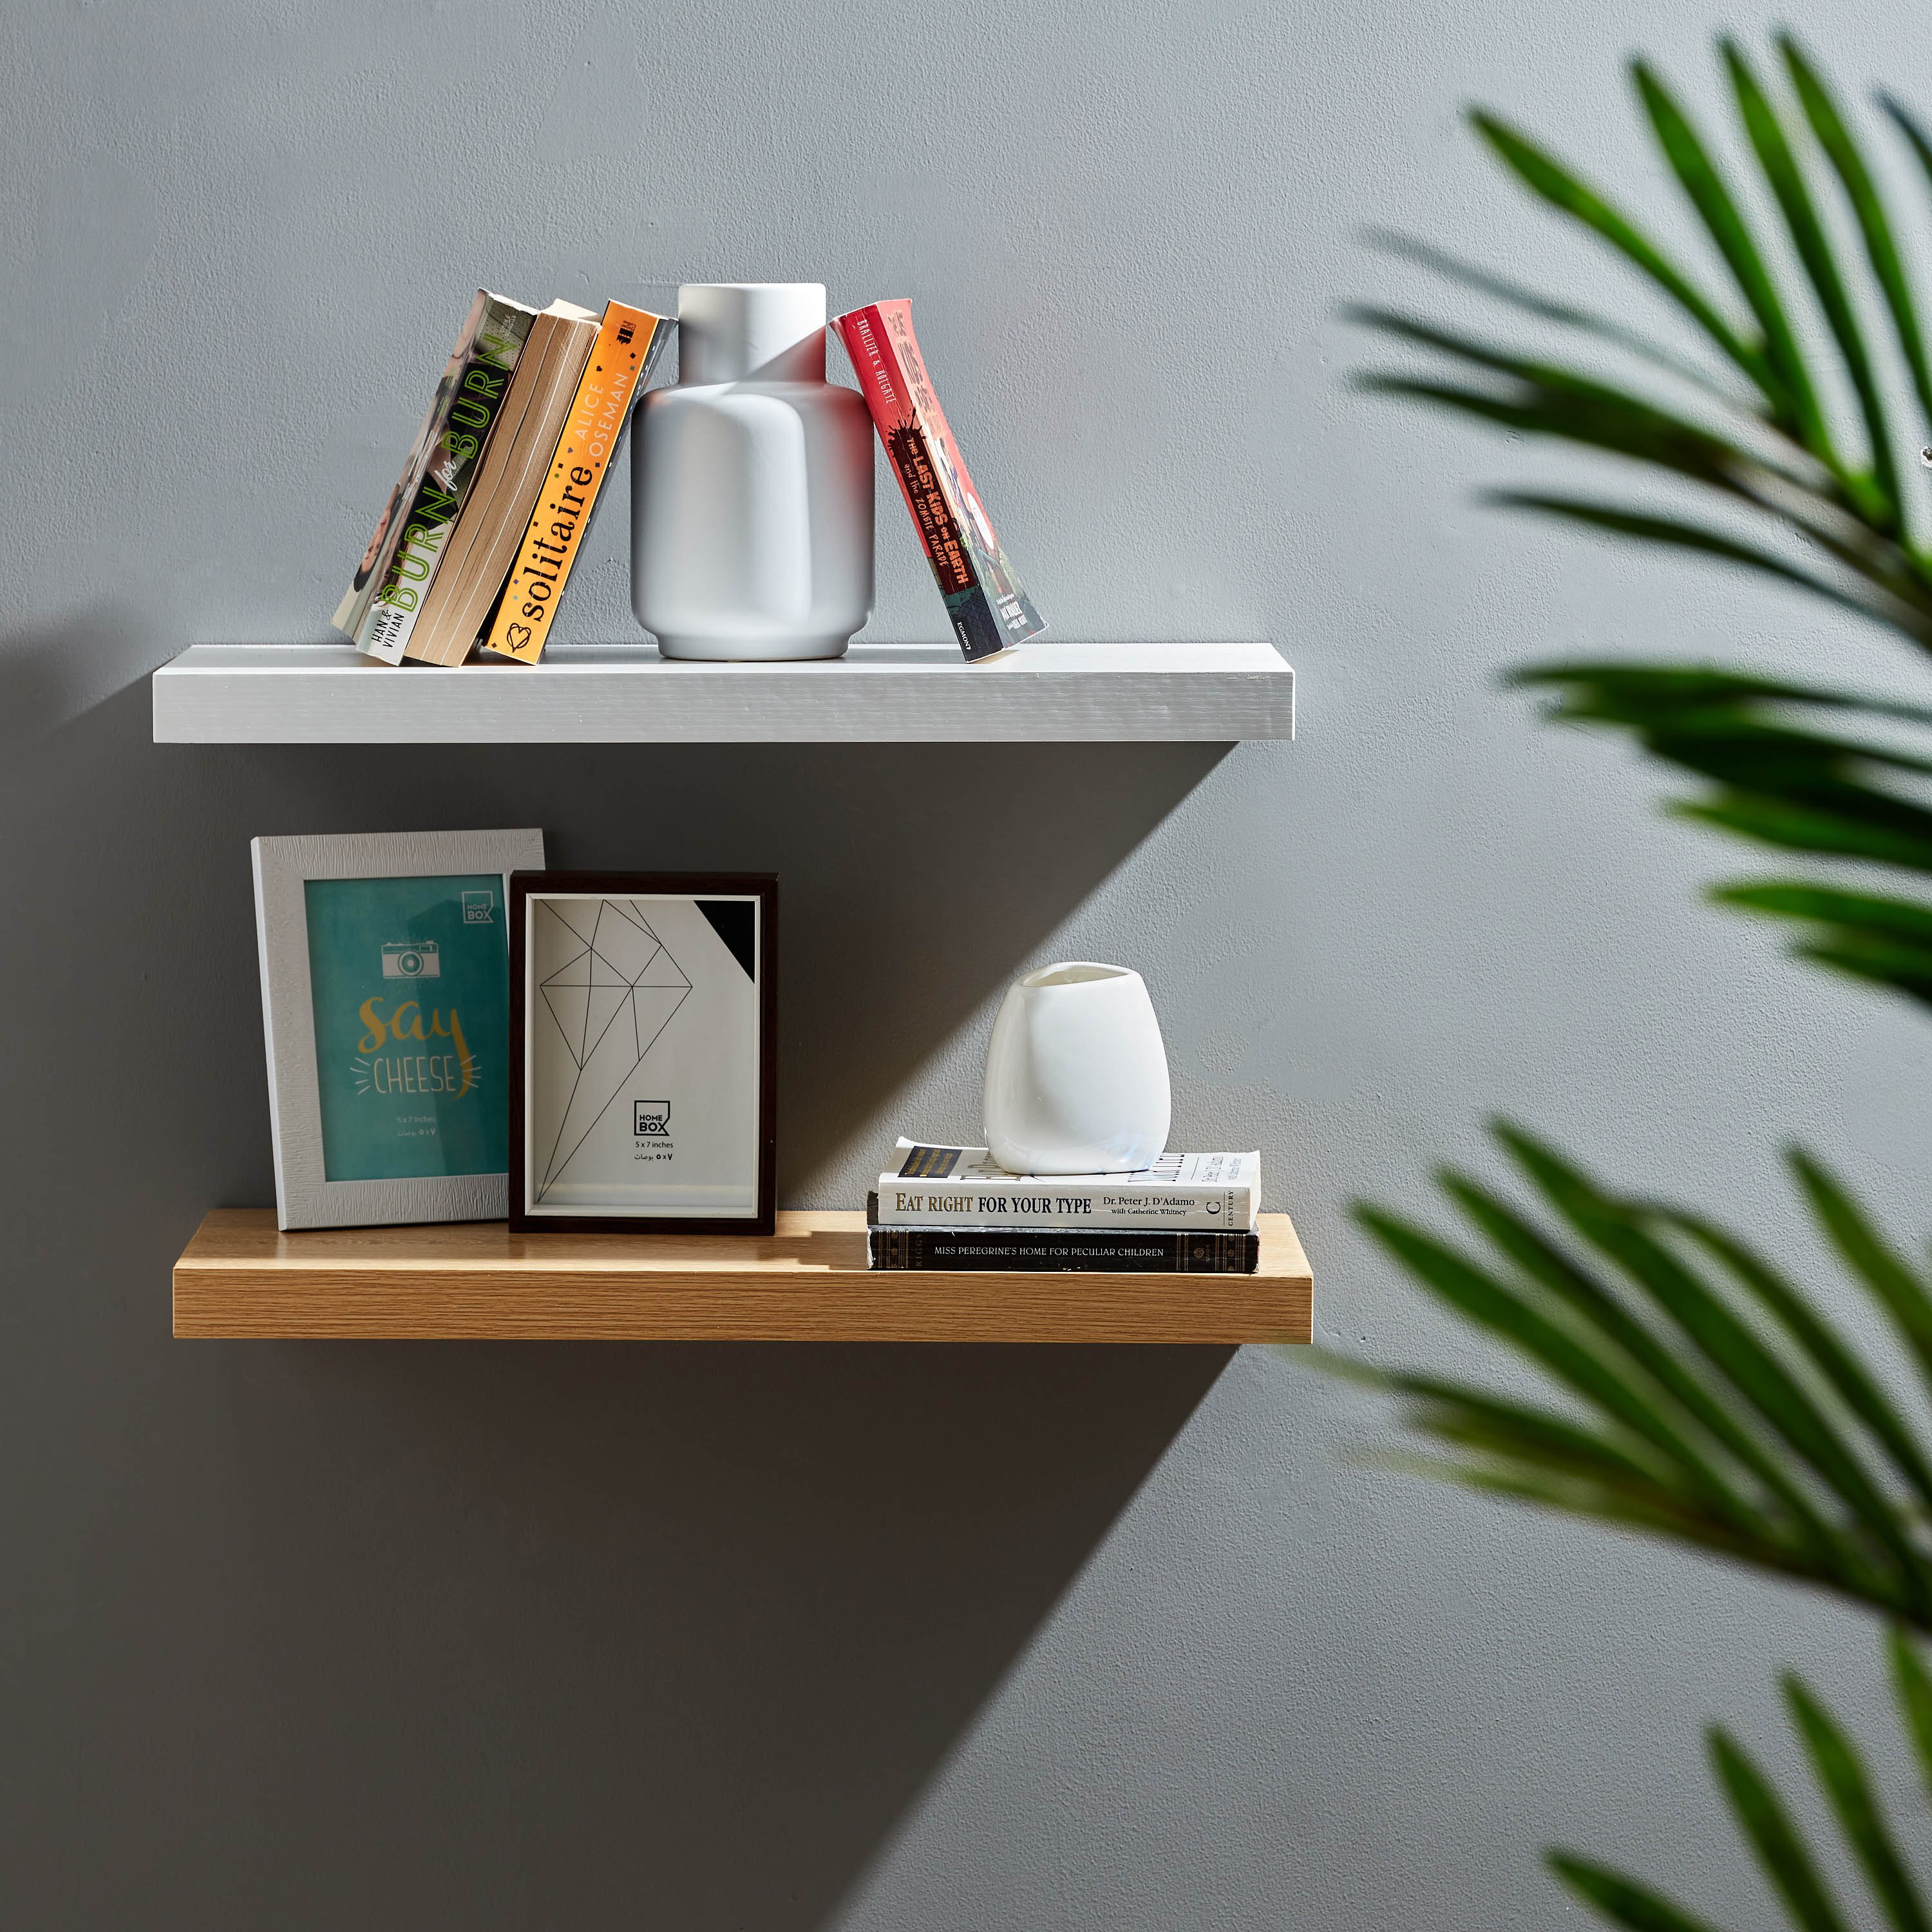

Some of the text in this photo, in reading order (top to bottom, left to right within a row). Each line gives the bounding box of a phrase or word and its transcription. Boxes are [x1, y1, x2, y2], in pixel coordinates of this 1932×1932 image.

[857, 319, 879, 356] BRALLIER
[875, 369, 897, 404] HOLGATE
[440, 332, 518, 460] BURN
[574, 383, 603, 440] ALICE
[589, 373, 629, 457] OSEMAN
[434, 460, 457, 491] for
[913, 455, 934, 489] LAST
[904, 463, 949, 567] and the ZOMBIE PARADE
[926, 491, 949, 526] KIDS
[381, 486, 457, 613] BURN
[522, 466, 592, 622] solitaire
[940, 526, 951, 540] ON
[943, 540, 969, 584] EARTH
[371, 609, 392, 643] HAN &
[382, 612, 404, 648] VIVIAN
[957, 621, 972, 650] EGMONT
[468, 911, 491, 920] BOX
[358, 996, 473, 1102] say
[374, 1056, 457, 1094] CHEESE
[413, 1115, 436, 1124] inches
[639, 1122, 668, 1132] BOX
[895, 1193, 1092, 1215] EAT RIGHT FOR YOUR TYPE
[1103, 1197, 1195, 1207] Dr. Peter J. D'Adamo
[934, 1246, 1164, 1256] MISS PEREGRINE'S HOME FOR PECULIAR CHILDREN
